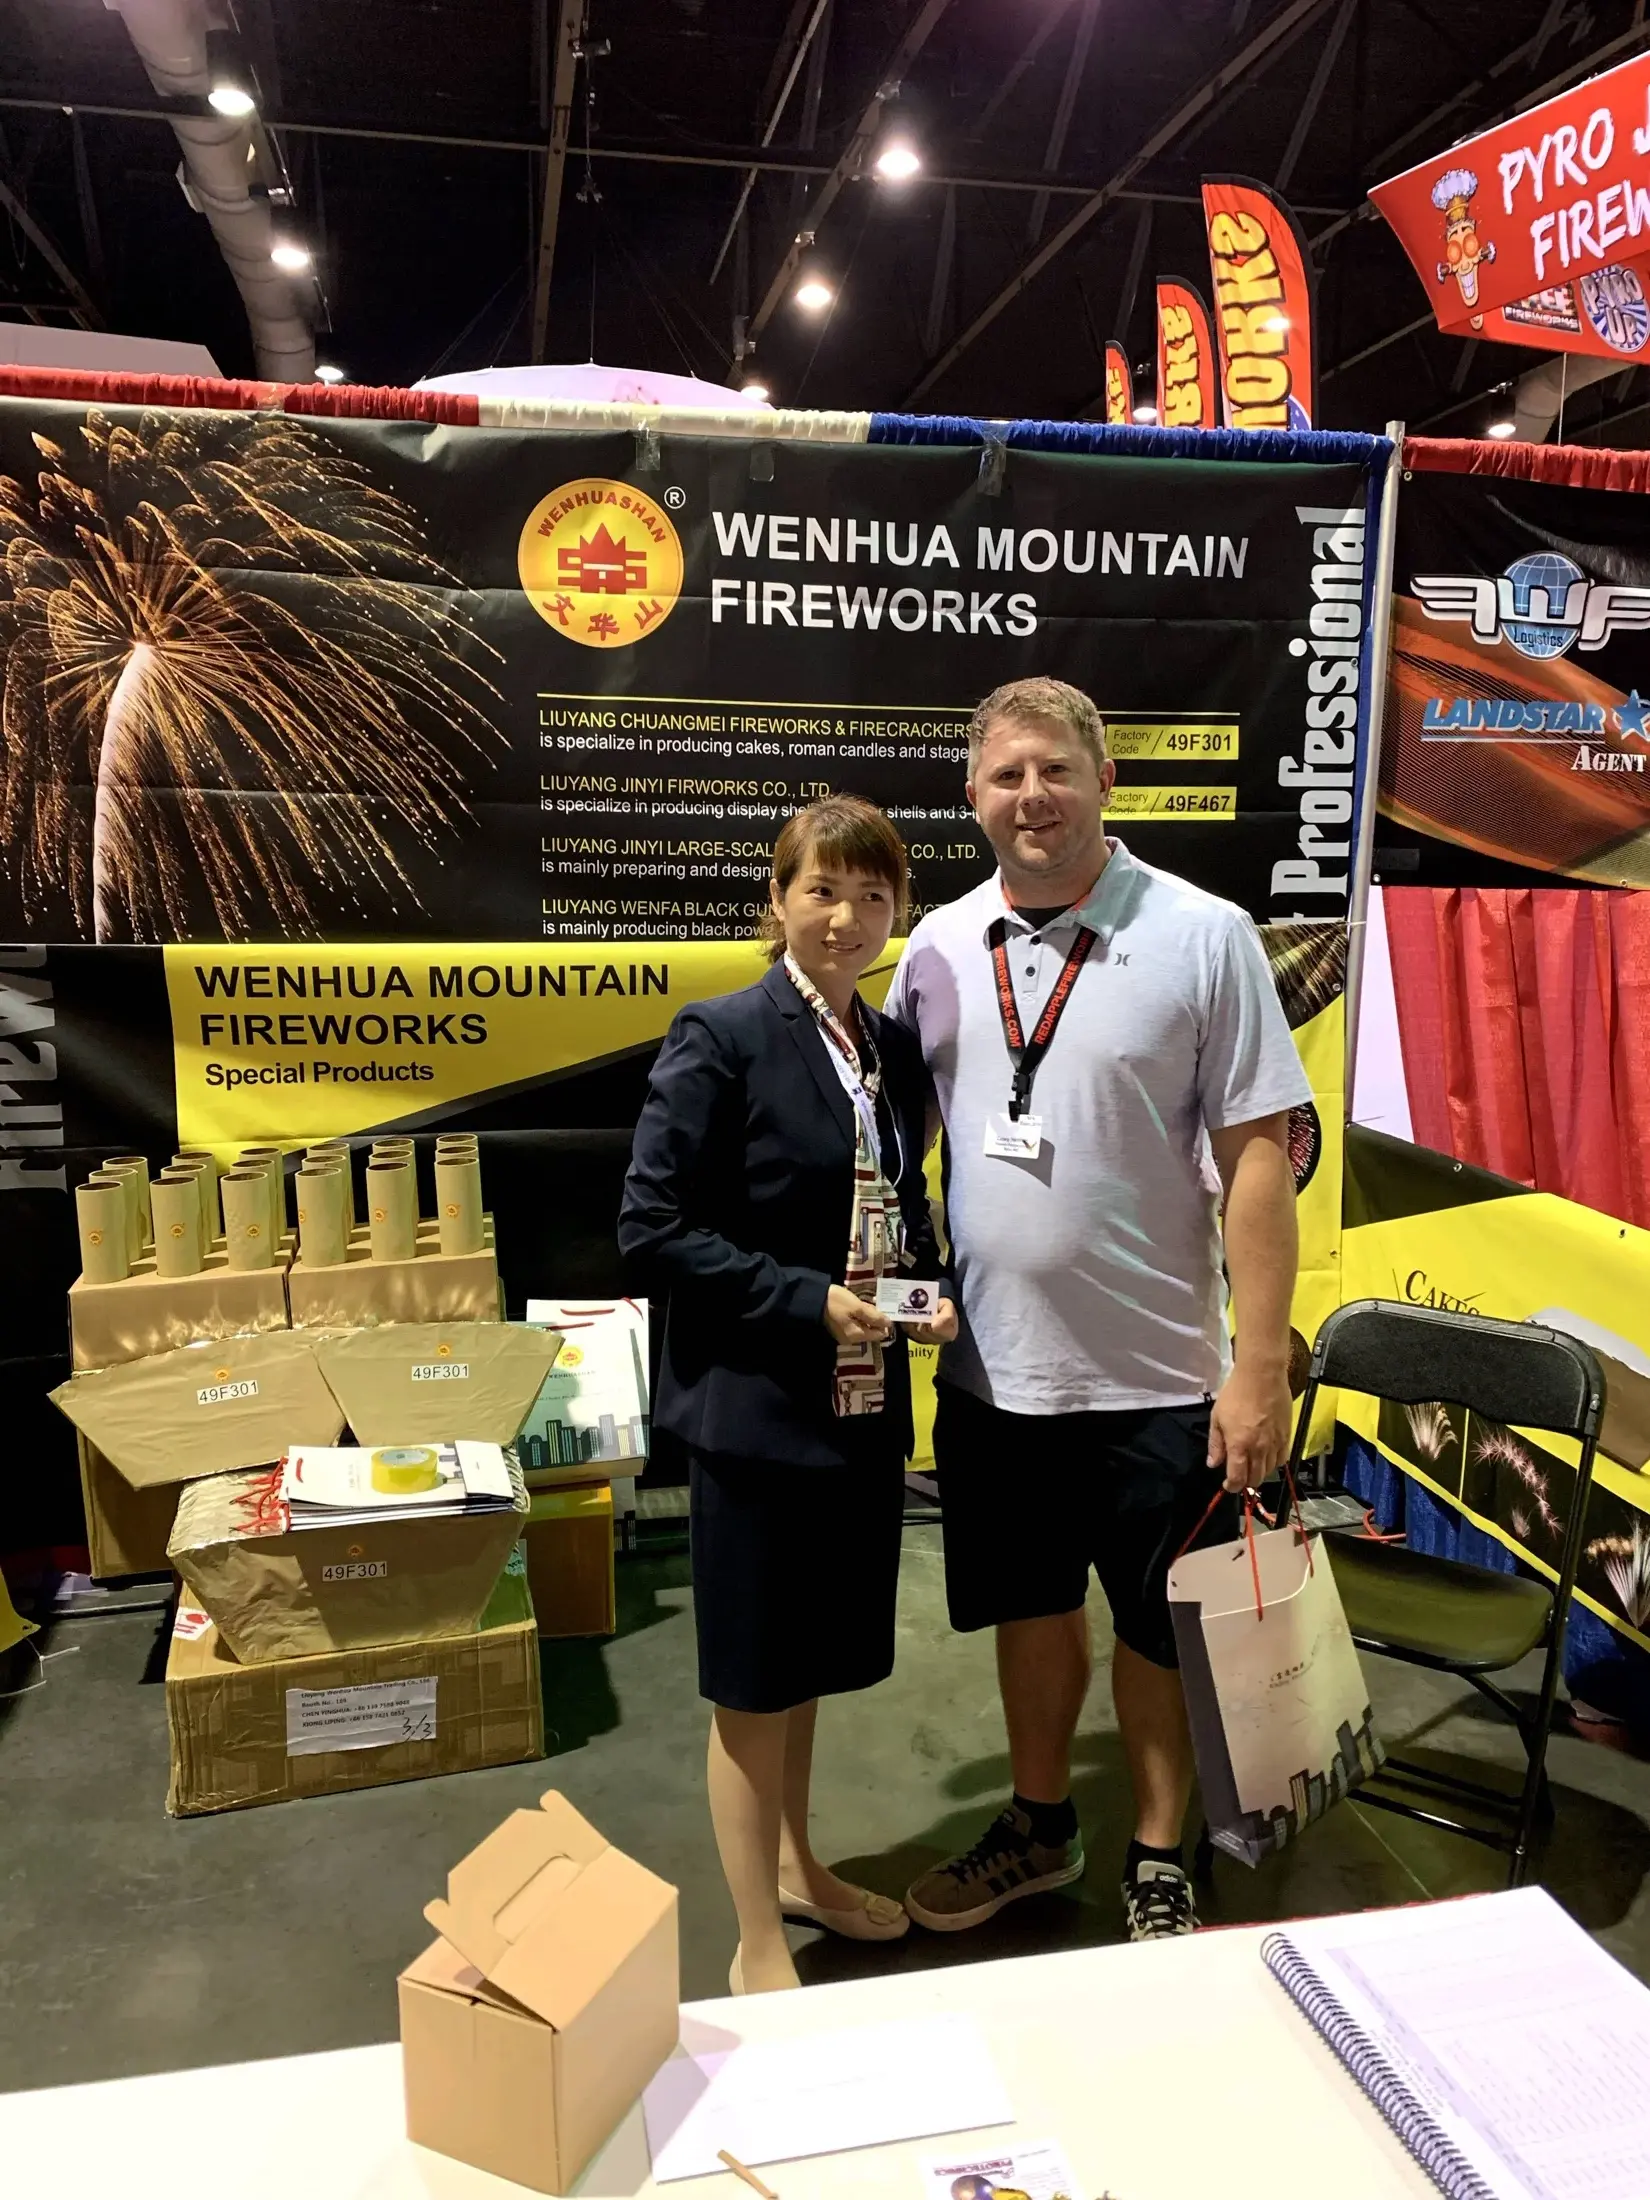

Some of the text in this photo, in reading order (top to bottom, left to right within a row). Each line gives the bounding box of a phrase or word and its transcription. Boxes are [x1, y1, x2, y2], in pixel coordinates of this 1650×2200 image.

[1498, 108, 1615, 215] PYRO
[1580, 269, 1644, 315] PYRO
[1606, 306, 1638, 344] UP
[537, 489, 668, 544] WENHUASHAN
[712, 511, 1249, 579] WENHUA MOUNTAIN
[711, 579, 1039, 636] FIREWORKS
[1513, 628, 1563, 648] Logistics
[1270, 506, 1366, 898] Professional
[540, 710, 616, 728] LIUYANG
[620, 713, 726, 731] CHUANGMEI
[730, 717, 831, 735] FIREWORKS
[835, 722, 846, 736] &
[1422, 697, 1606, 734] LANDSTAR
[540, 731, 553, 747] is
[557, 734, 635, 752] specialize
[639, 735, 653, 750] in
[657, 737, 732, 757] producing
[736, 739, 784, 757] cakes,
[789, 744, 836, 757] roman
[839, 743, 895, 758] candles
[899, 744, 926, 758] and
[1113, 729, 1151, 742] Factory
[1166, 734, 1231, 751] 49F301
[1112, 744, 1139, 755] Code
[541, 775, 616, 792] LIUYANG
[620, 777, 663, 794] JINYI
[668, 778, 758, 796] FIRWORKS
[762, 781, 795, 799] CO.,
[541, 798, 553, 811] is
[556, 799, 631, 814] specialize
[635, 800, 648, 814] in
[651, 801, 724, 819] producing
[727, 802, 777, 820] display
[887, 806, 926, 819] shells
[929, 806, 956, 819] and
[1165, 795, 1230, 812] 49F467
[541, 838, 616, 854] LIUYANG
[621, 839, 663, 855] JINYI
[911, 843, 943, 861] CO.,
[947, 844, 980, 859] LTD.
[541, 860, 554, 873] is
[558, 860, 608, 877] mainly
[613, 862, 685, 880] preparing
[690, 863, 717, 877] and
[542, 899, 616, 915] LIUYANG
[621, 900, 681, 916] WENFA
[685, 902, 739, 917] BLACK
[543, 921, 555, 935] is
[559, 921, 608, 939] mainly
[613, 923, 687, 940] producing
[691, 924, 730, 938] black
[195, 964, 669, 1000] WENHUA MOUNTAIN
[199, 1013, 488, 1047] FIREWORKS
[205, 1060, 435, 1087] Special Products
[412, 1365, 469, 1379] 49F301
[199, 1382, 258, 1404] 49F301
[324, 1562, 387, 1580] 49F301
